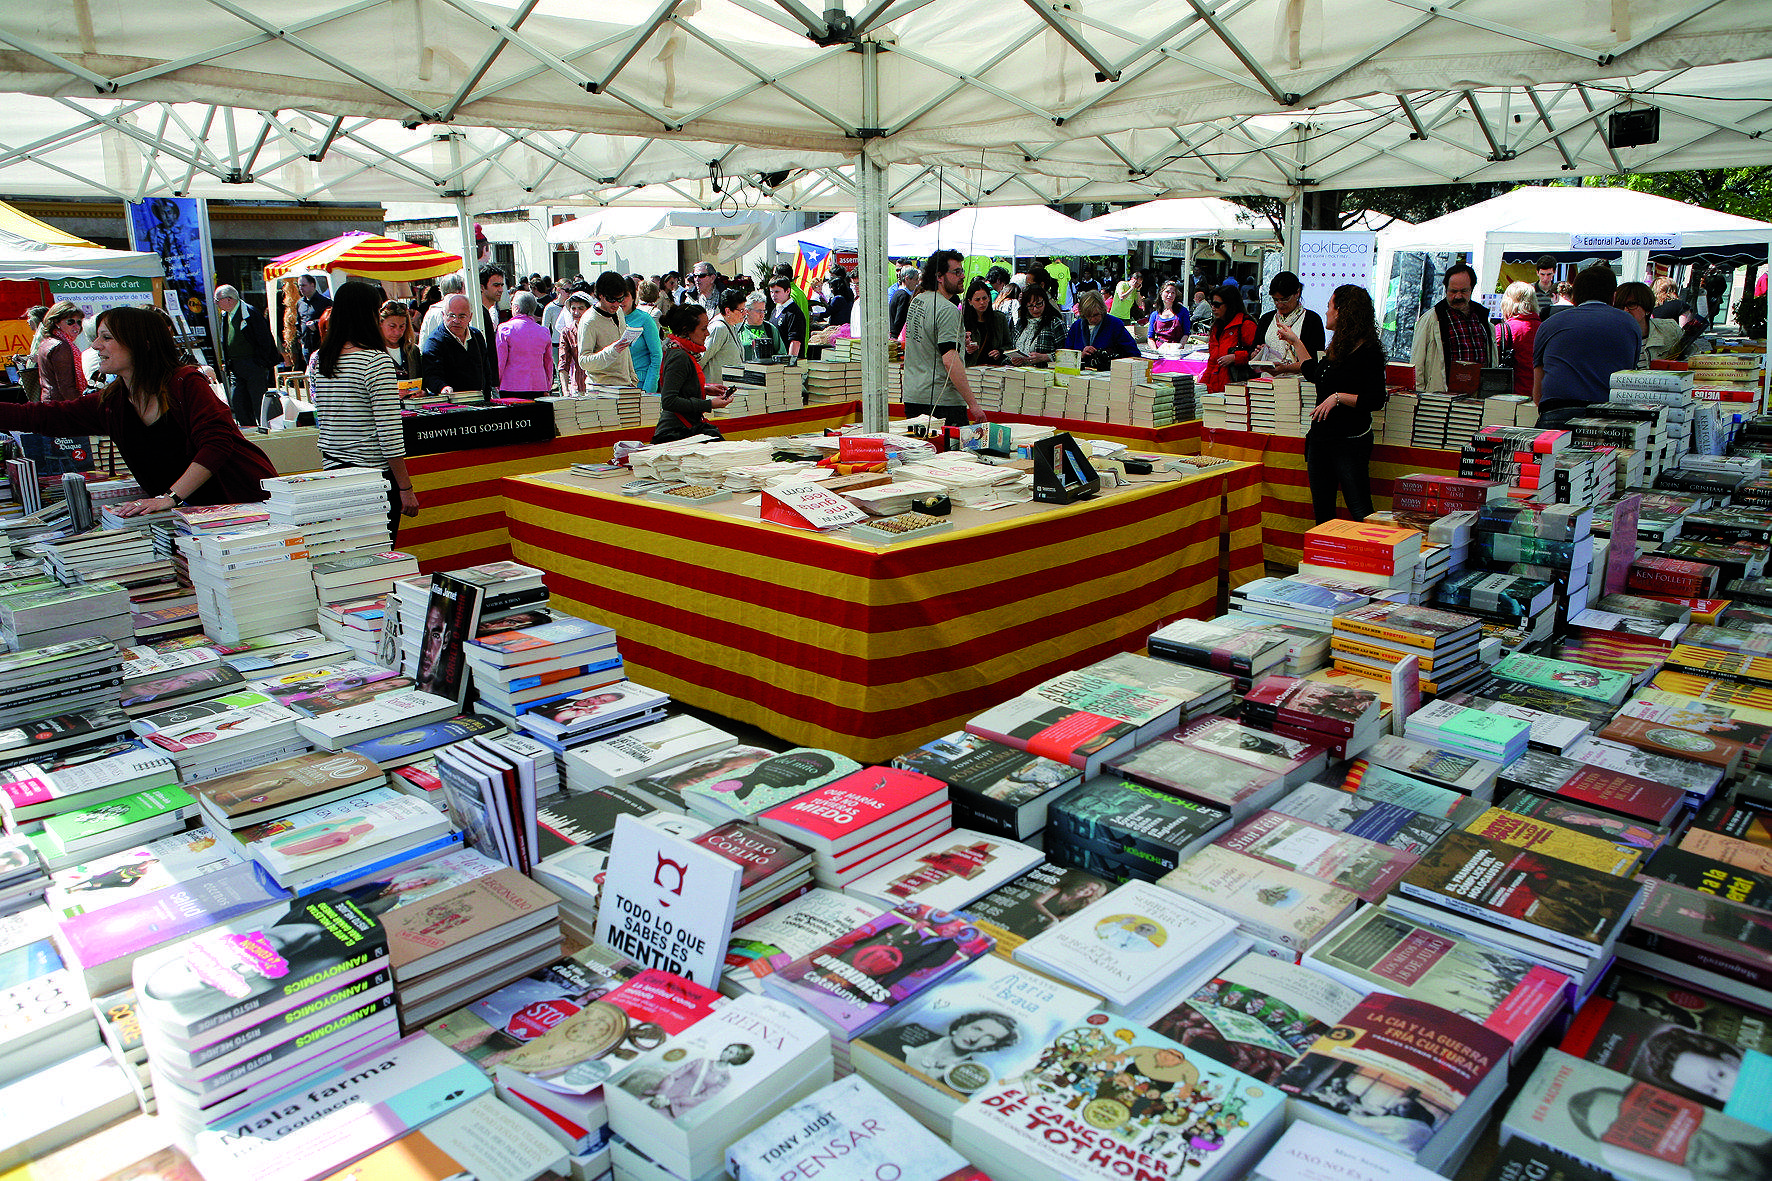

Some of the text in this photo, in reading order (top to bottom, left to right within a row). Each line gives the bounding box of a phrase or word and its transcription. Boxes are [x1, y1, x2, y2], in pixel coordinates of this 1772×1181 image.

[1301, 240, 1367, 253] ookiteca
[1584, 237, 1672, 246] Editorial Pau de Damasc
[122, 280, 140, 288] d'art
[1616, 376, 1669, 385] KEN FOLLETT
[1616, 391, 1669, 400] KEN FOLLETT
[1694, 391, 1721, 400] VICTUS
[417, 420, 532, 440] LOS JUEGOS DEL HAMBRE
[1701, 415, 1709, 431] KEN
[800, 491, 829, 501] leer
[1660, 481, 1724, 493] JOHN GRISHAM
[798, 498, 837, 510] gusta
[823, 504, 848, 515] me
[1636, 570, 1694, 586] KEN FOLLETT
[456, 594, 467, 630] MORIR
[1038, 673, 1086, 701] ANTONY
[1051, 679, 1109, 705] BEEVOR
[1173, 718, 1221, 741] Crimen
[949, 749, 1020, 783] POSTGUERRA
[951, 750, 993, 770] TONY JUDT
[810, 797, 860, 816] TUVIERAS
[842, 799, 859, 808] NO
[848, 791, 886, 809] HARÍAS
[1118, 781, 1200, 810] THOMPSON
[791, 801, 854, 825] MIEDO
[728, 830, 777, 856] PAULO
[1227, 815, 1284, 852] Sinn Féin
[708, 835, 770, 866] COELHO
[1445, 849, 1492, 892] EL FRANQUISMO,
[1481, 857, 1497, 871] DEL
[1468, 861, 1505, 900] HOLOCAUSTO
[170, 891, 207, 919] salud
[334, 900, 369, 933] RISTO MEJIDE
[616, 895, 706, 955] TODO LO QUE
[625, 917, 688, 962] SABES ES
[608, 925, 695, 982] MENTIRA
[1381, 930, 1429, 976] LOS MITOS DEL
[1396, 934, 1444, 982] 18 DE JULIO
[284, 954, 368, 995] #ANNOYOMICS
[813, 954, 892, 1003] DIVENDRES
[285, 981, 368, 1023] #ANNOYOMICS
[803, 971, 869, 1010] catalunya
[234, 1001, 259, 1017] RISTO
[235, 1029, 261, 1046] RISTO
[296, 1004, 376, 1047] #ANNOYOMICS
[1366, 1012, 1489, 1067] LA CIA Y LA GUERRA
[1384, 1026, 1414, 1046] FRÍA
[1416, 1036, 1481, 1077] CULTURAL
[247, 1053, 272, 1070] RISTO
[220, 1056, 398, 1145] Mala farma
[981, 1096, 1022, 1117] DE
[1003, 1090, 1030, 1106] EL
[276, 1093, 361, 1137] Goldacre
[759, 1111, 838, 1165] TONY JUDT
[780, 1119, 886, 1181] PENSAR
